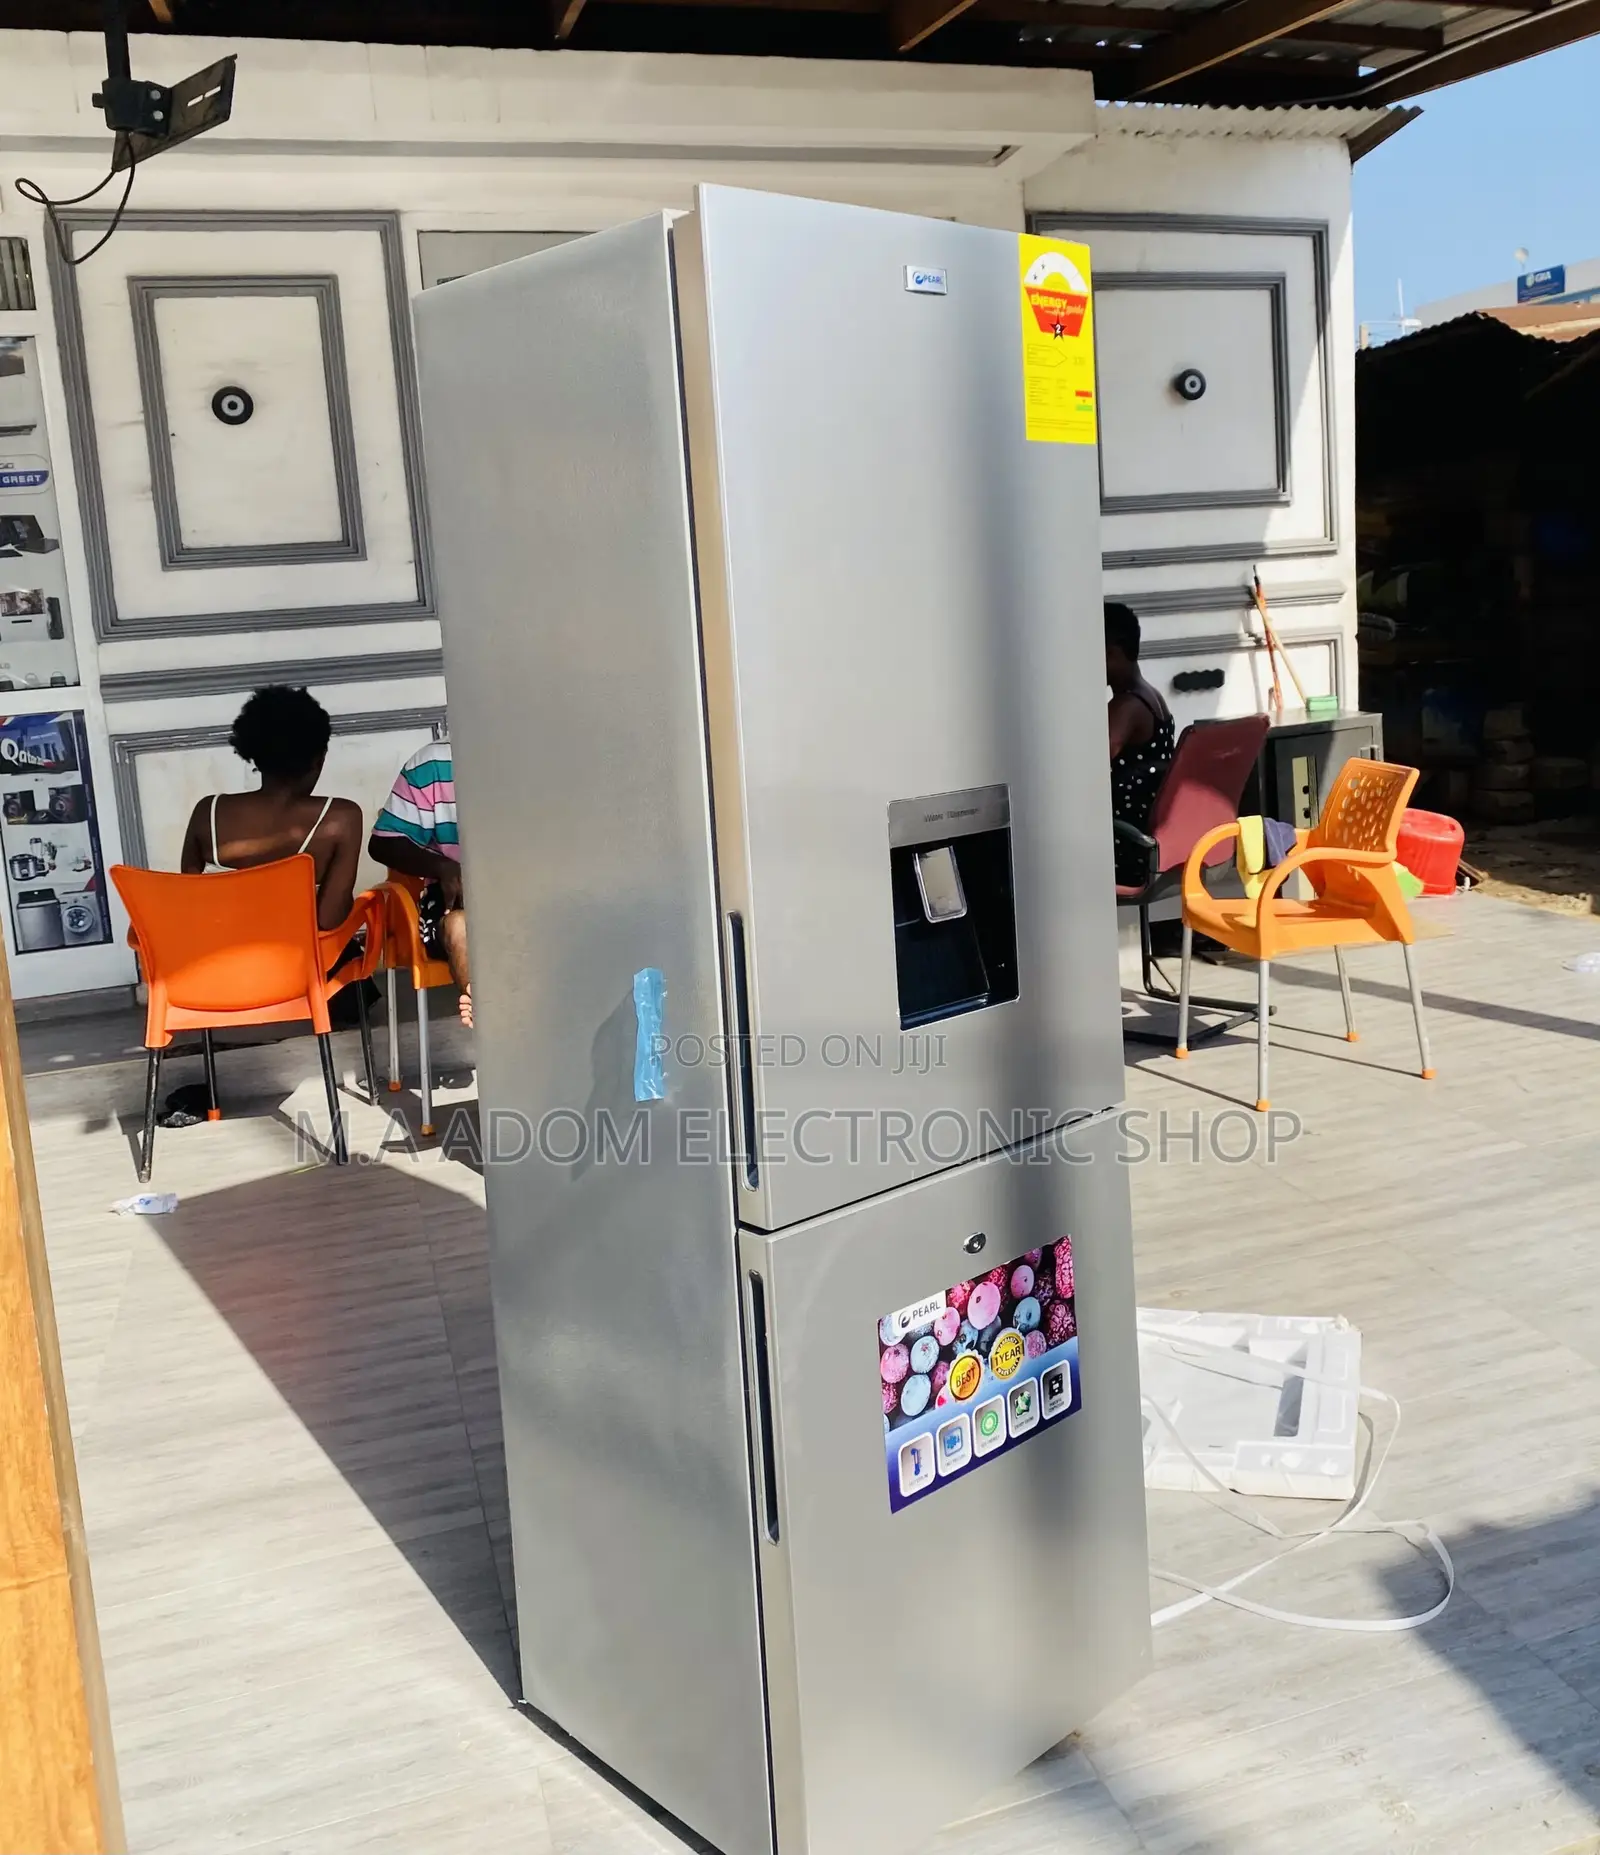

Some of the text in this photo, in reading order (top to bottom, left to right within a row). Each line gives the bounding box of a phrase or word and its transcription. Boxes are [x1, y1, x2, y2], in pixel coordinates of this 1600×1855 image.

[1055, 324, 1061, 334] 2
[2, 474, 41, 484] GREAT
[912, 1300, 941, 1319] PEARL
[1000, 1346, 1021, 1363] YEAR
[956, 1367, 976, 1388] BEST
